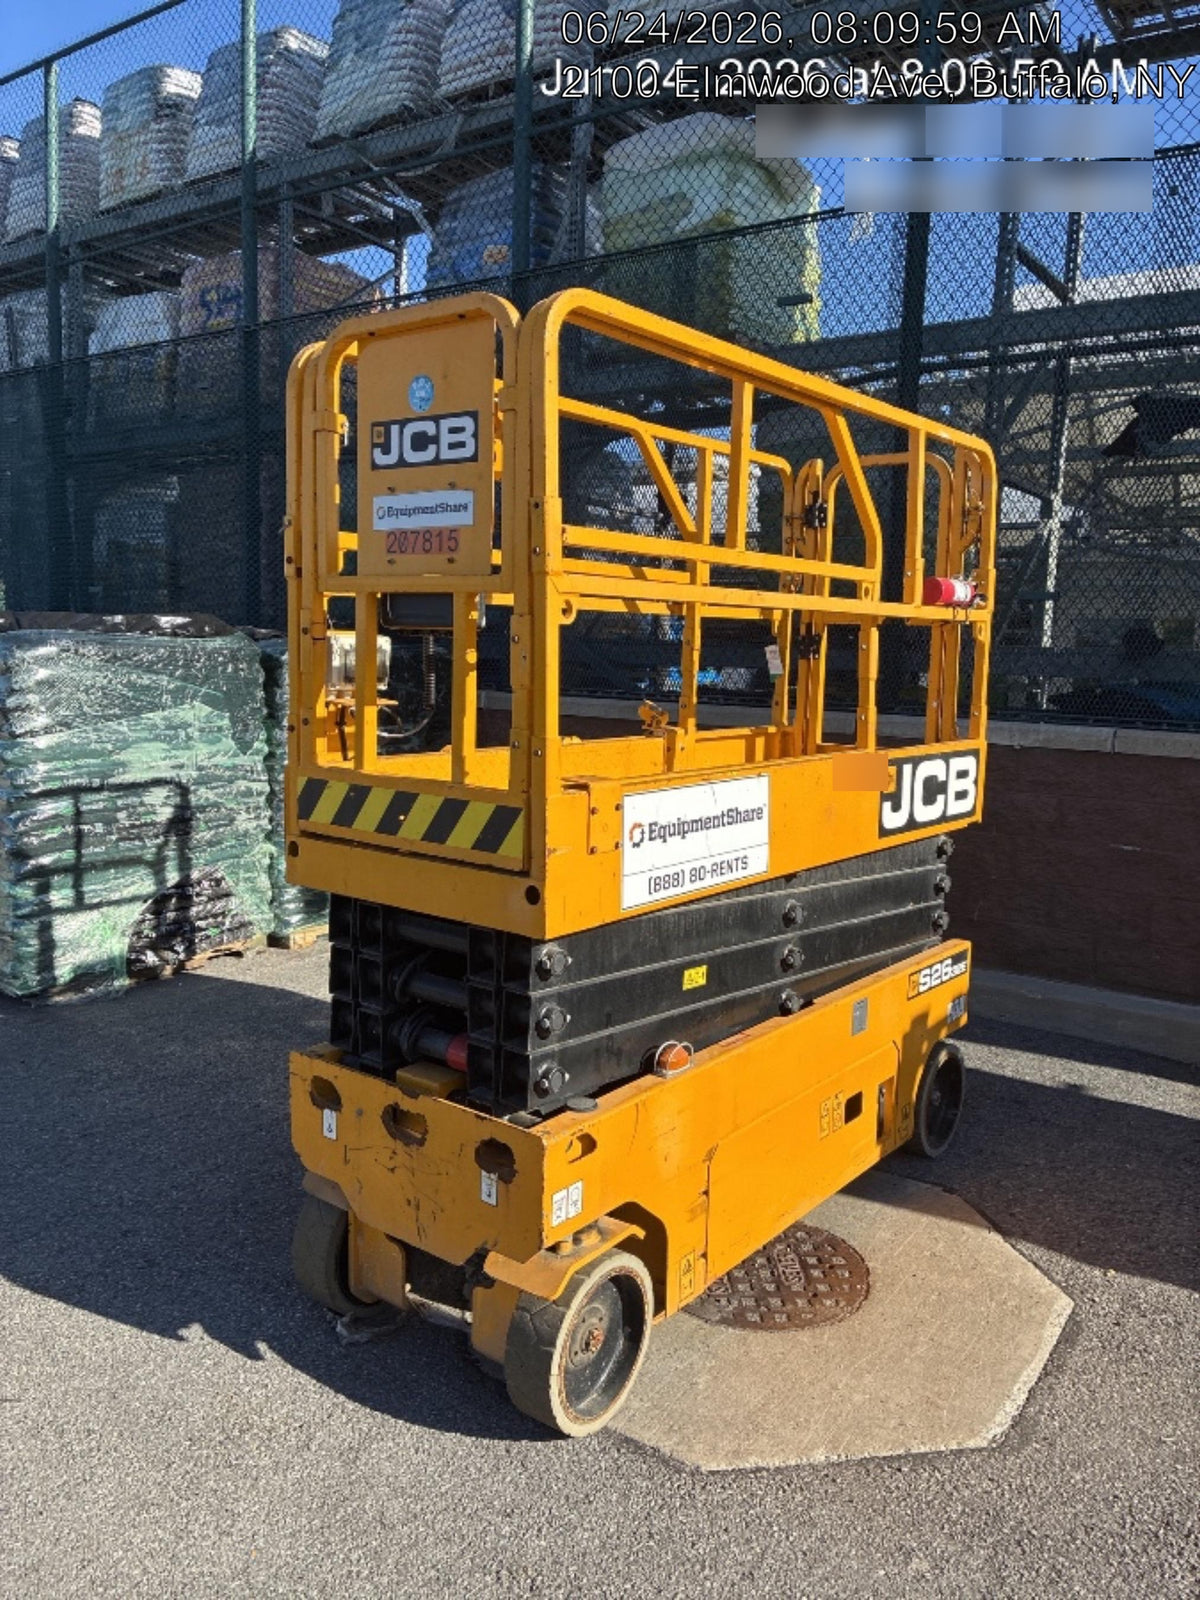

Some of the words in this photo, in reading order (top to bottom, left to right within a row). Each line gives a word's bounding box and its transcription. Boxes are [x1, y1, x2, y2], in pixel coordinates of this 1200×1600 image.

[373, 415, 476, 466] JCB
[386, 502, 468, 519] EquipmentShare
[386, 529, 459, 554] 207815
[881, 755, 978, 831] JCB
[648, 806, 764, 844] EquipmentShare
[648, 867, 686, 896] (888)
[689, 854, 749, 884] 80-RENTS
